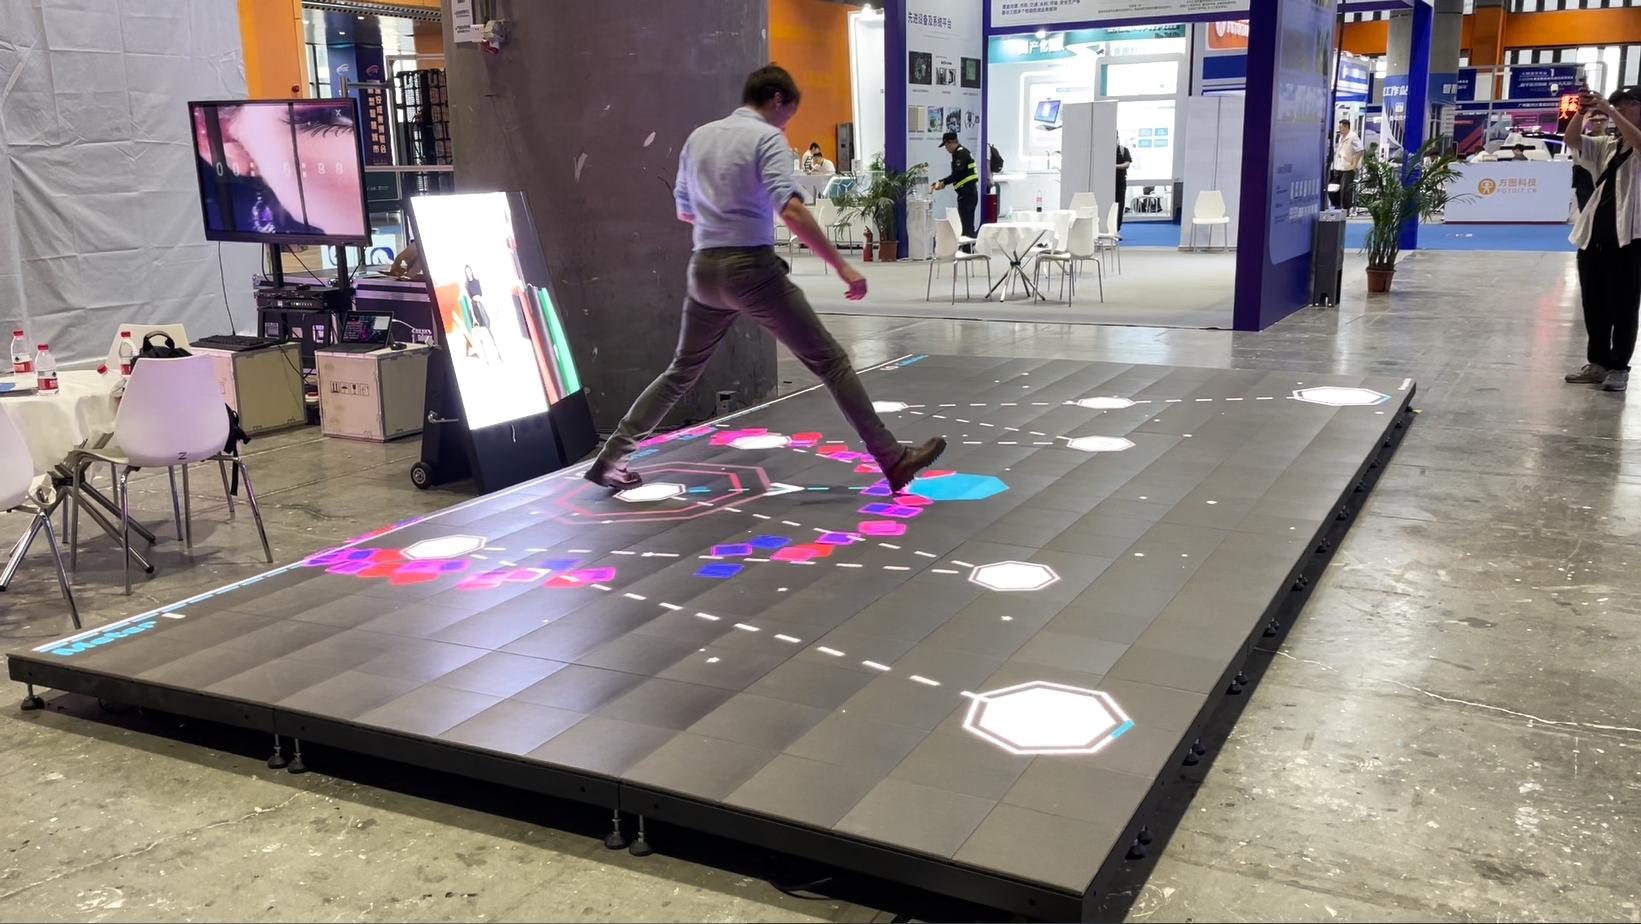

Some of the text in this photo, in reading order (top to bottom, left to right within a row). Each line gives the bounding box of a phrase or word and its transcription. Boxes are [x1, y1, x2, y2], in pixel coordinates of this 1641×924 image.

[908, 11, 952, 30] 先进设备及系统平台
